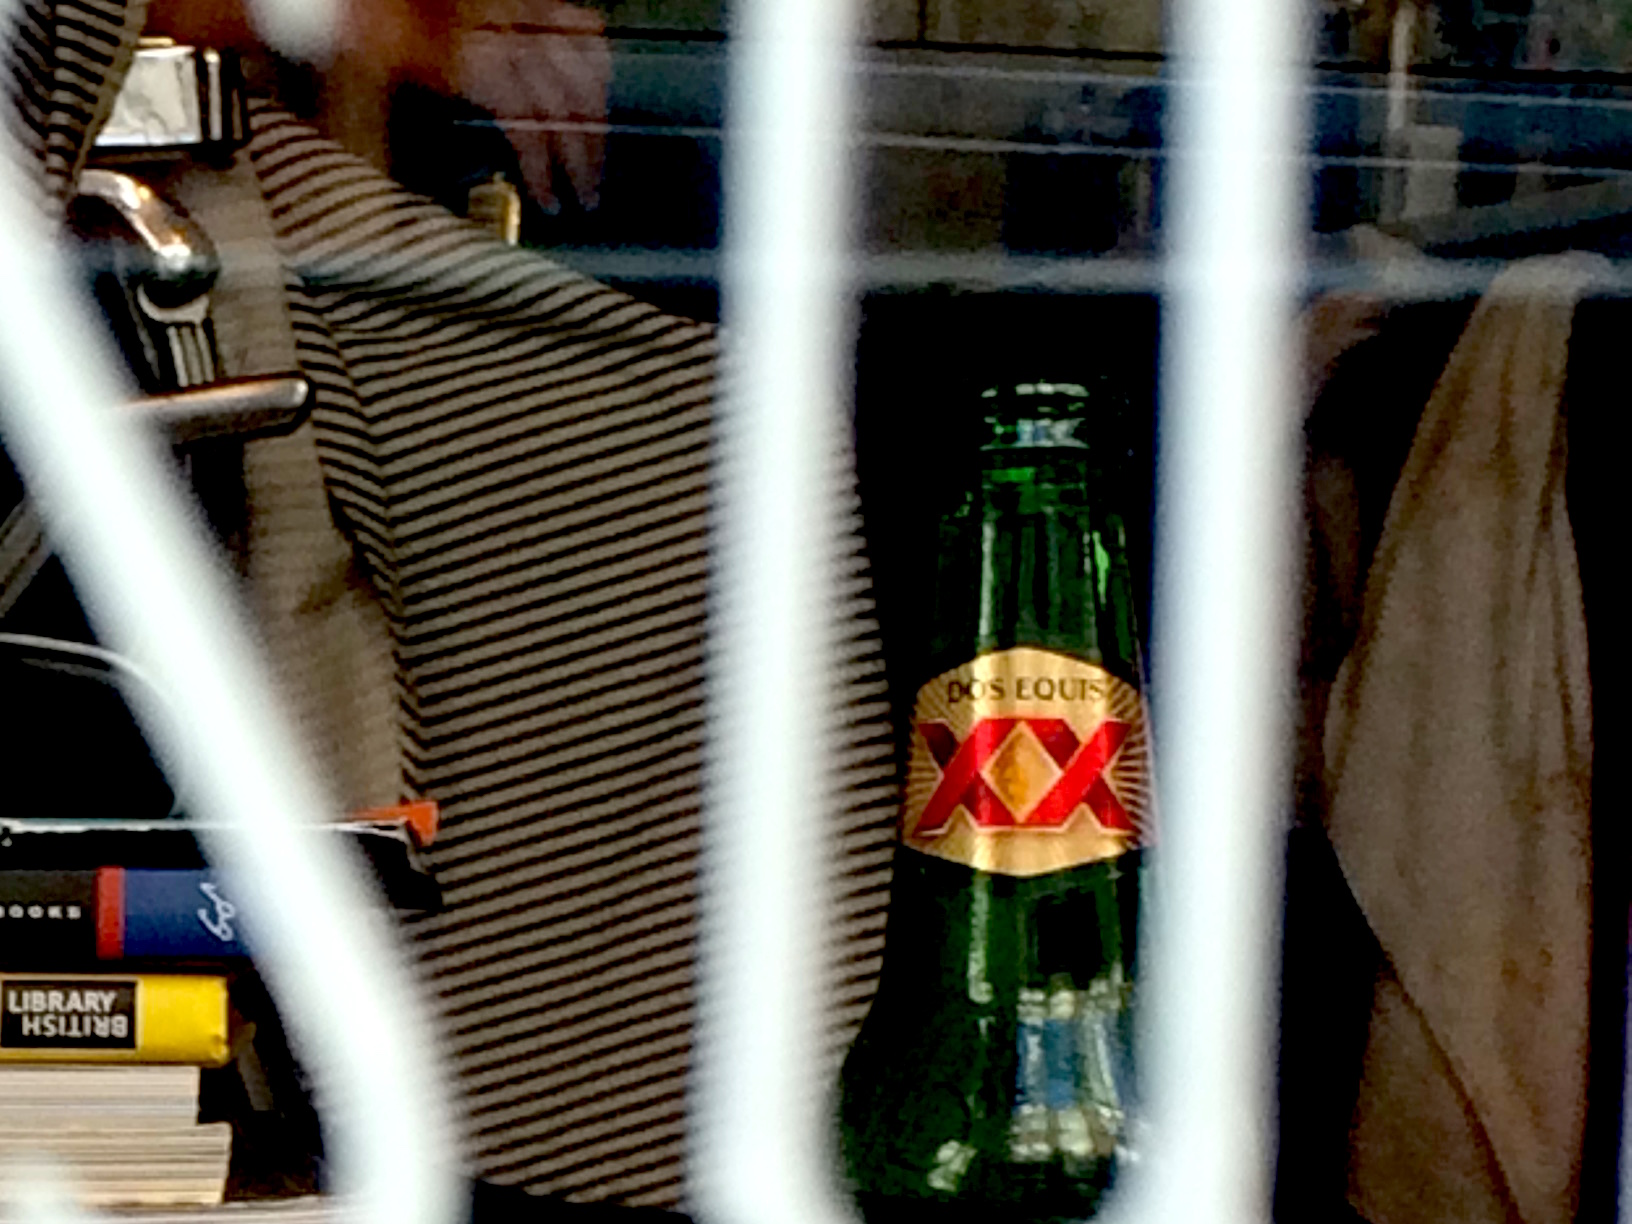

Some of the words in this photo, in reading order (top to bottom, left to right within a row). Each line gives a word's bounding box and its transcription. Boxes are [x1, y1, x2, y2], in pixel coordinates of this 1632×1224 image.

[947, 677, 1006, 704] DOS
[1014, 677, 1106, 703] EQUIS
[8, 990, 117, 1014] LIBRARY
[21, 1014, 128, 1038] BRITISH
